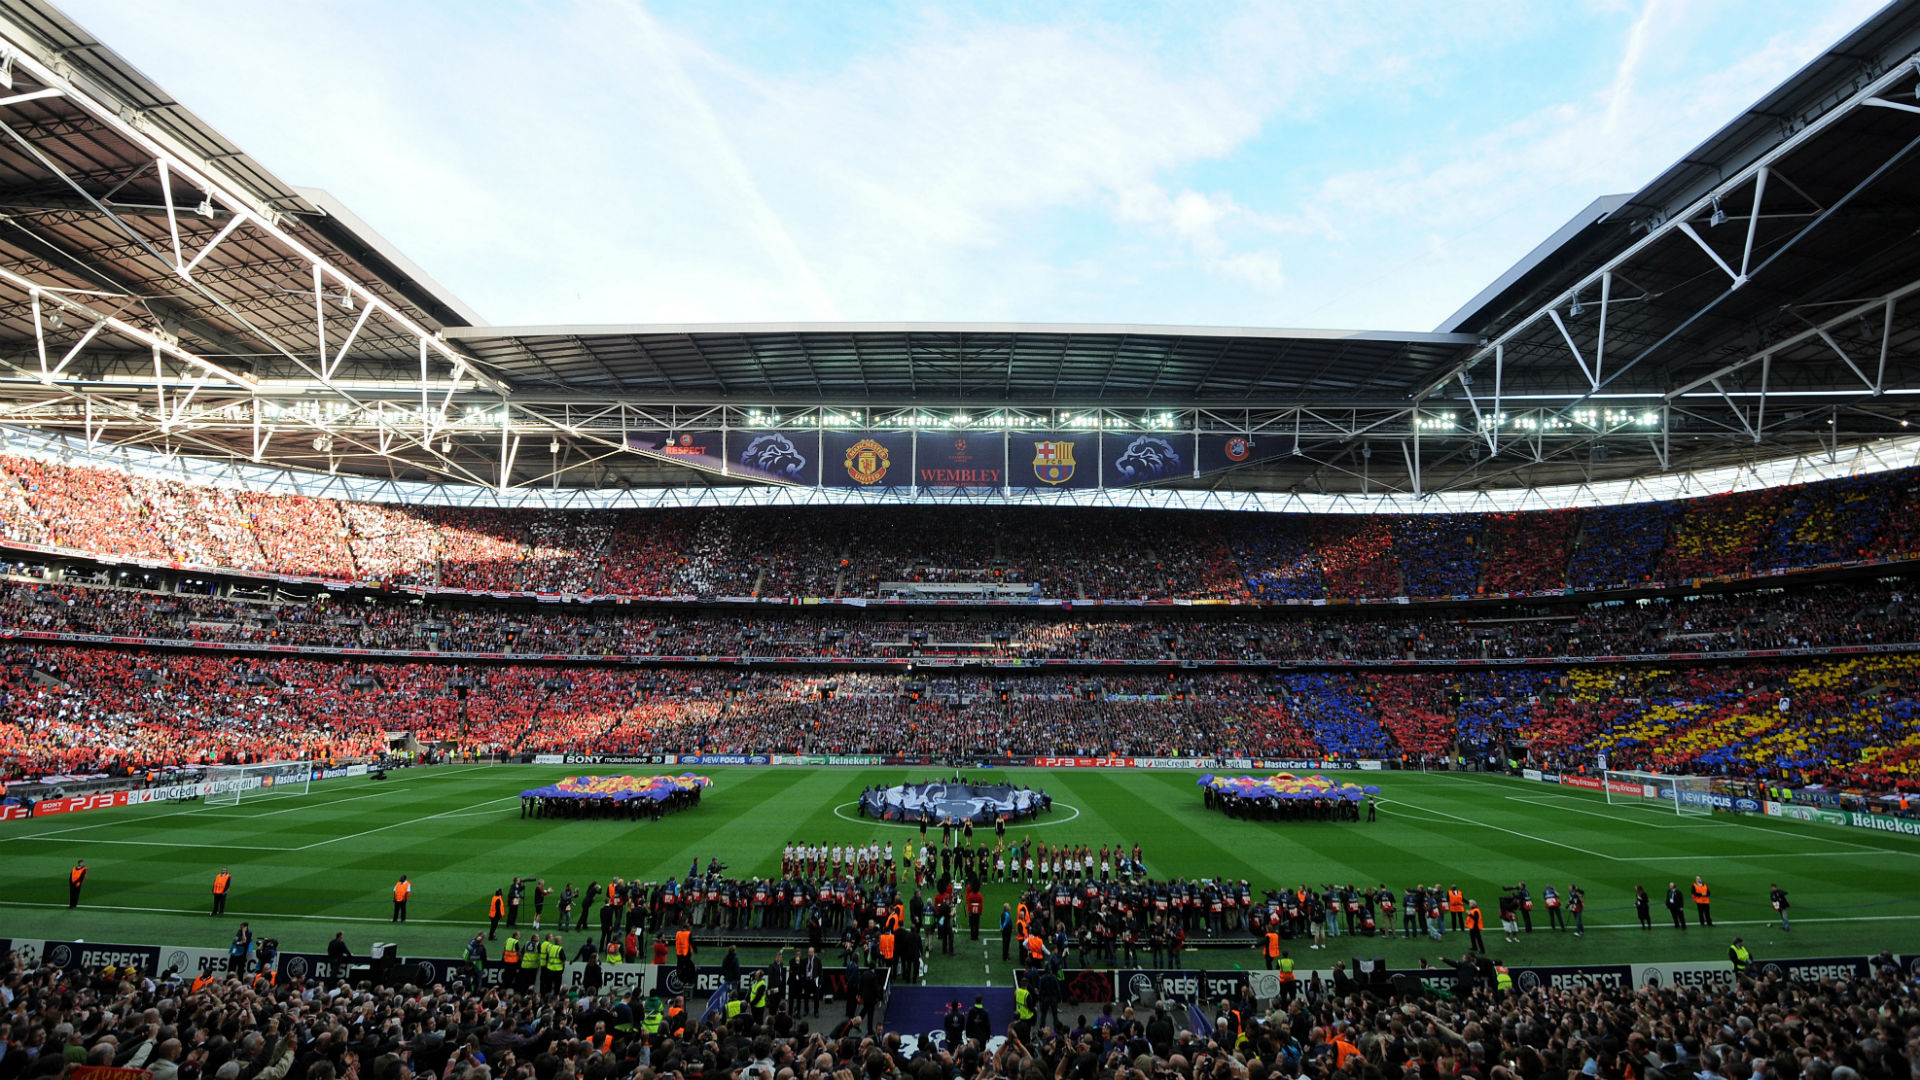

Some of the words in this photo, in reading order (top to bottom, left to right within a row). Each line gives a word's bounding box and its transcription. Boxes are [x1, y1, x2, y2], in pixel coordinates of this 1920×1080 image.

[666, 446, 707, 455] RESPECT
[849, 442, 885, 457] MANCHESTER
[855, 474, 880, 482] UNITED
[921, 469, 1000, 481] WEMBLEY
[829, 756, 870, 764] Heineken
[1046, 758, 1075, 766] PS3
[1096, 758, 1125, 766] PS3
[323, 768, 346, 779] Maestro
[154, 785, 197, 800] UniCredit
[1682, 792, 1701, 803] NEW
[1702, 794, 1732, 808] FOCUS
[70, 794, 114, 812] PS3
[1852, 813, 1920, 836] Heineken
[82, 951, 150, 969] RESPECT
[571, 970, 645, 990] RPECT
[1790, 965, 1857, 982] RESPECT
[1163, 979, 1238, 997] RESECT
